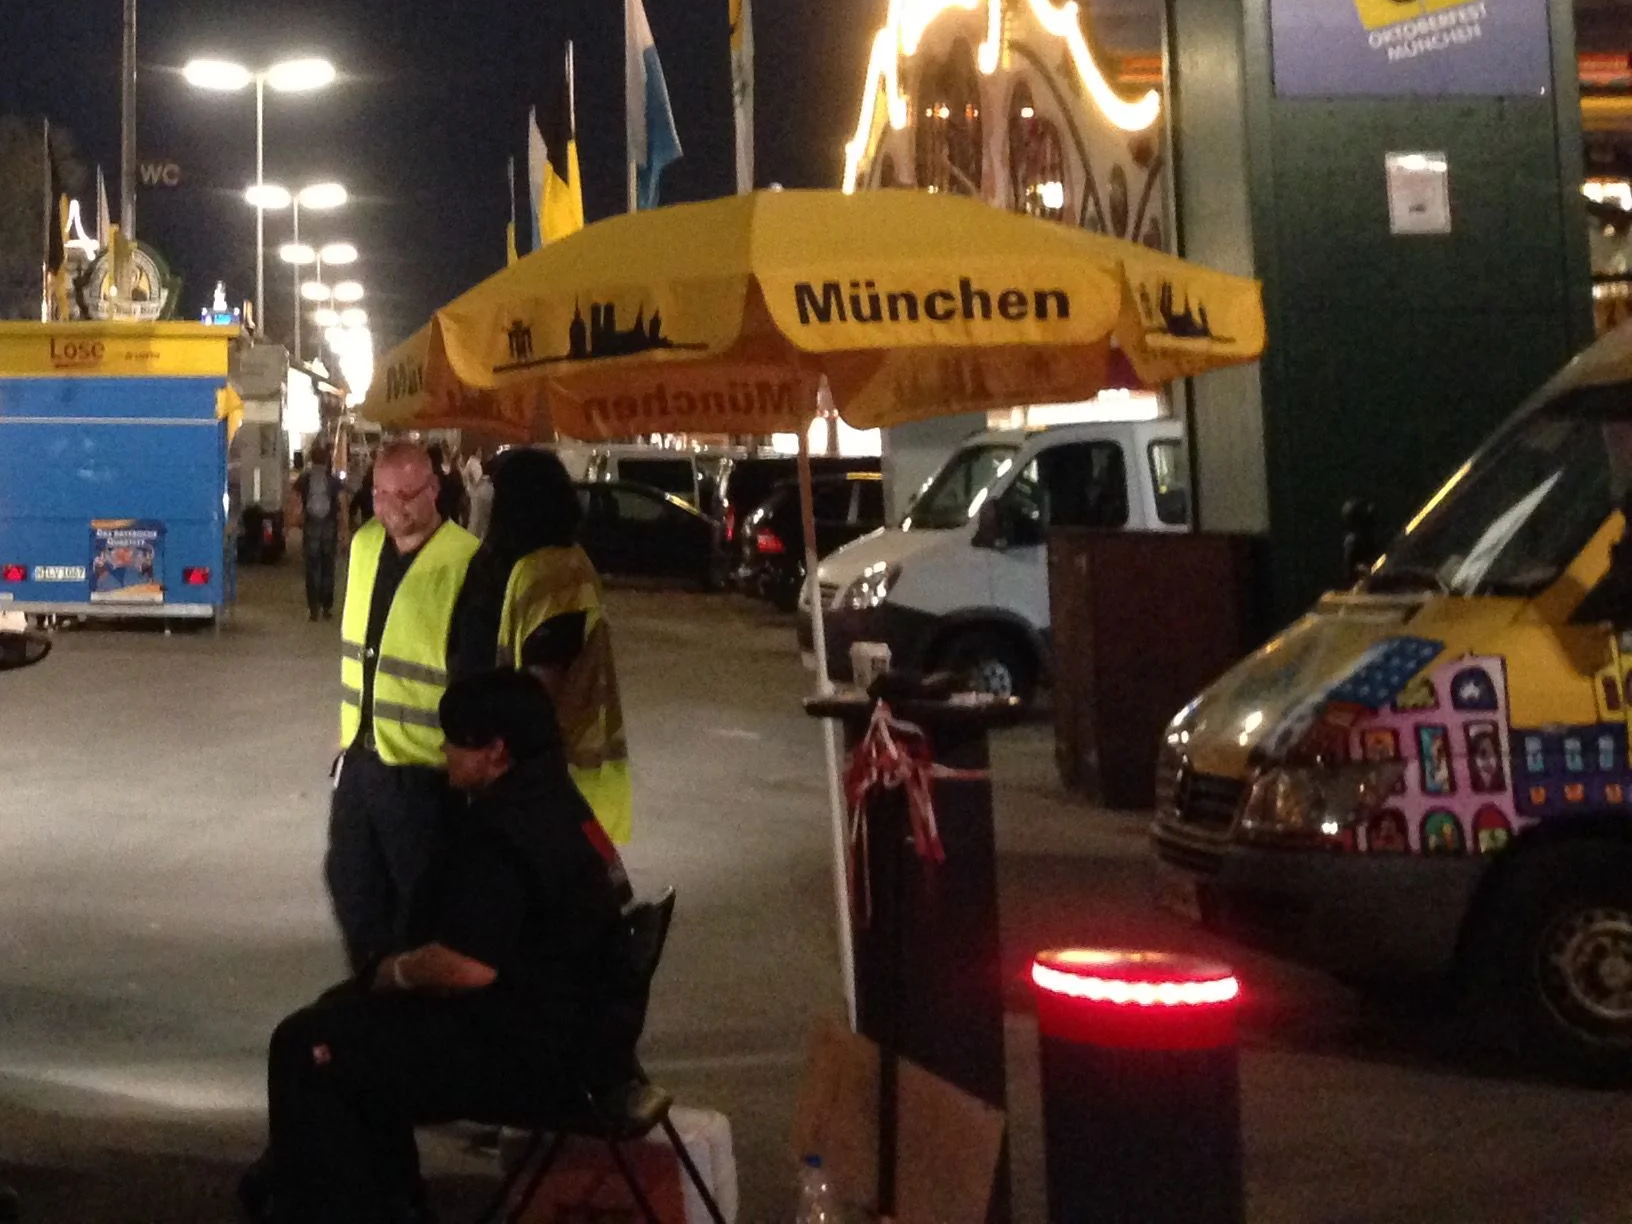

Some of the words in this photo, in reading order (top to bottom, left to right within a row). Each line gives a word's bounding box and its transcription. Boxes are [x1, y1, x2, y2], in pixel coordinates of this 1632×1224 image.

[1368, 1, 1487, 49] OKTOBERFEST
[140, 163, 181, 187] WC
[794, 277, 1071, 327] München
